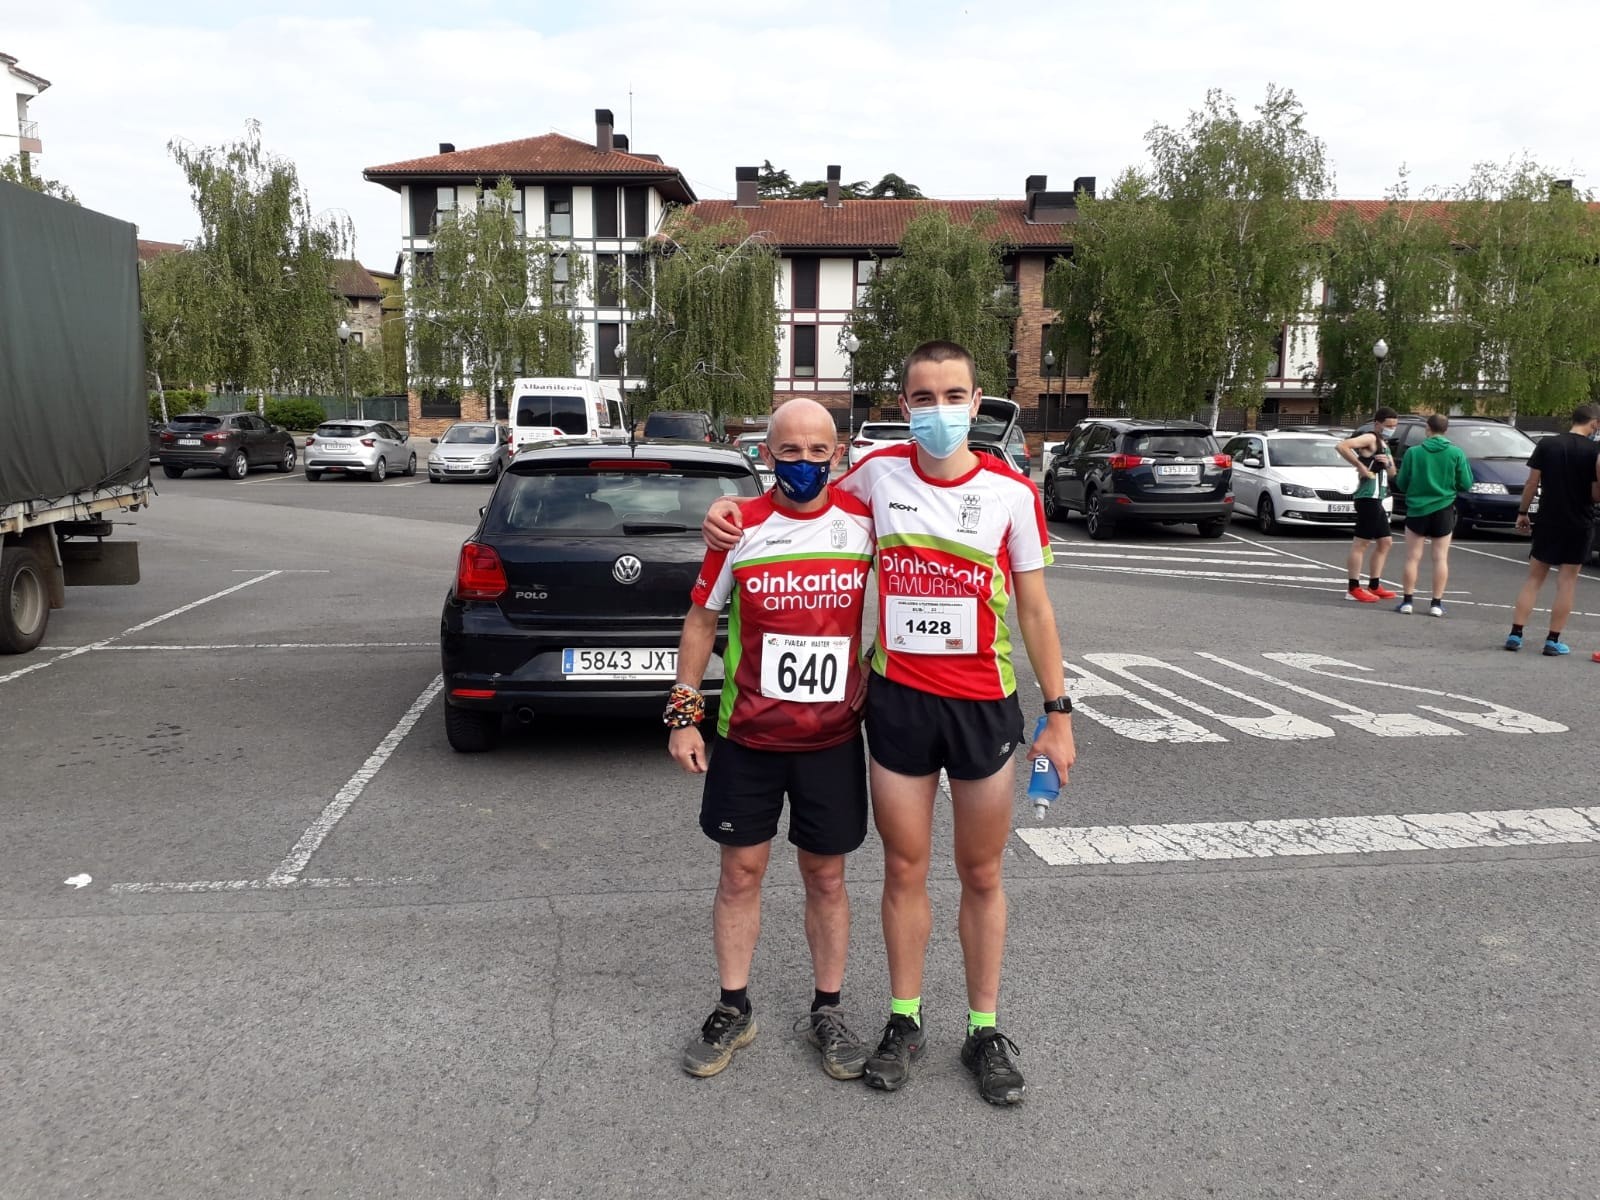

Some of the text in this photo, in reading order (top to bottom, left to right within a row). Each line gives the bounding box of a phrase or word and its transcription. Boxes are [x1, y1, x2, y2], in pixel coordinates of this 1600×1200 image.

[888, 574, 979, 596] AMURRIO
[515, 591, 548, 600] POLO
[763, 593, 852, 611] amurrio
[905, 619, 952, 635] 1428
[580, 651, 678, 671] 5843 JXT
[777, 651, 838, 695] 640
